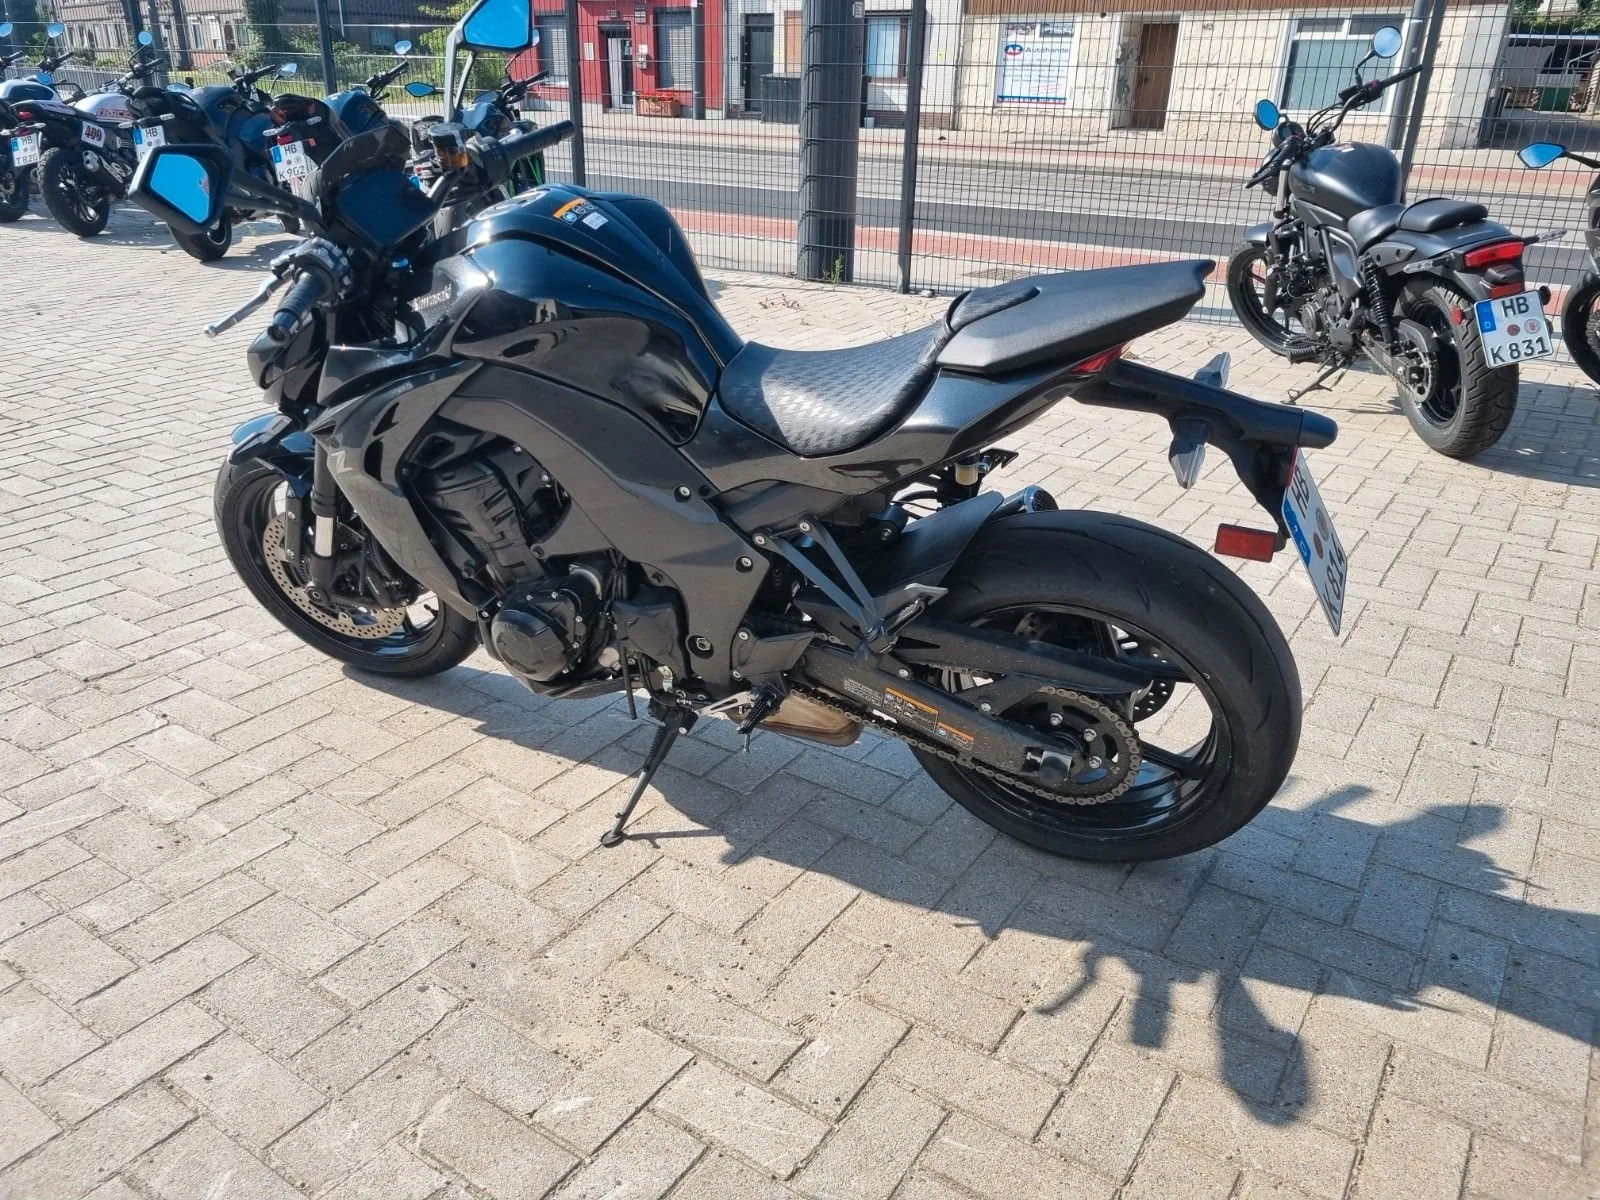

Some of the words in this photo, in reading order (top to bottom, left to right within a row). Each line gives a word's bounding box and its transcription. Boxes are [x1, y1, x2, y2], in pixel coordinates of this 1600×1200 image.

[22, 136, 32, 145] HB
[146, 128, 158, 138] HB
[284, 144, 297, 156] HB
[279, 171, 286, 179] K
[1501, 296, 1529, 317] HB
[1485, 321, 1491, 329] D
[1490, 346, 1505, 364] K
[1508, 337, 1548, 359] 831
[1291, 465, 1309, 519] HB
[1327, 533, 1344, 601] 814
[1323, 582, 1339, 625] K
